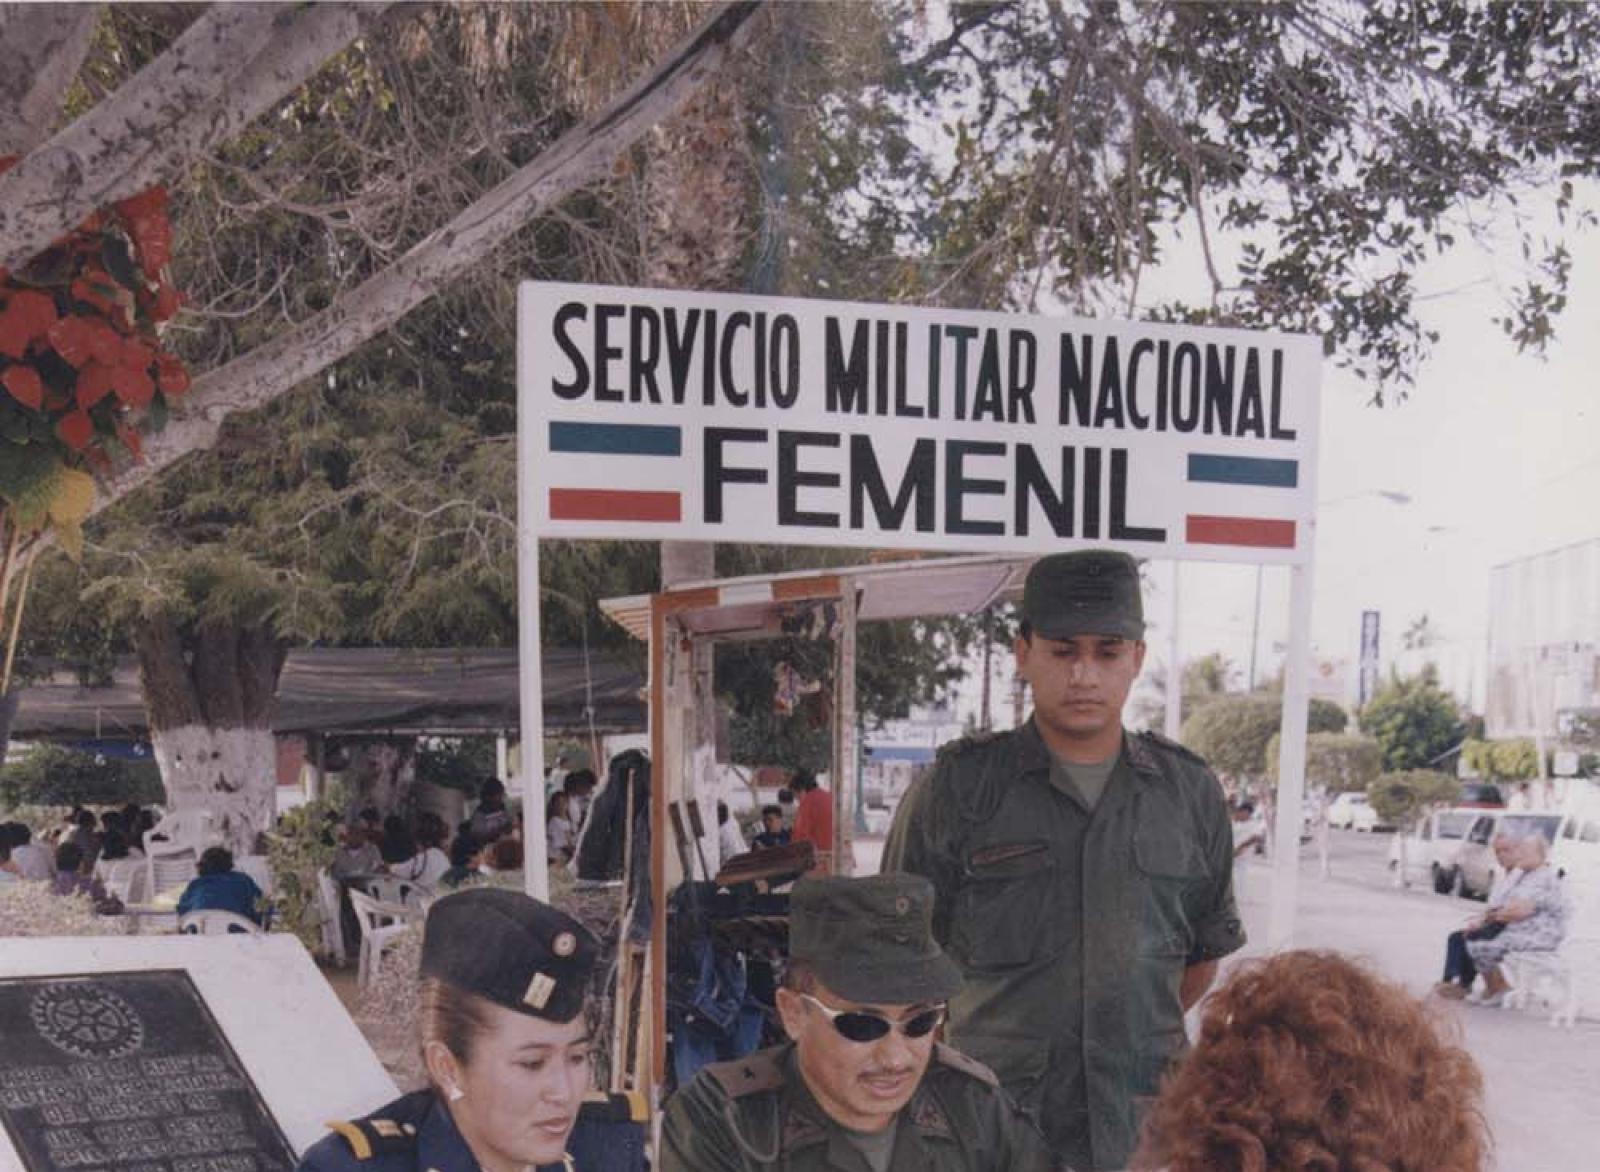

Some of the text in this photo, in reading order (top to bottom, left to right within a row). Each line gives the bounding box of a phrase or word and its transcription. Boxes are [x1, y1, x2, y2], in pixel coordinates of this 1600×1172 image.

[552, 301, 1297, 441] SERVICIO MILITAR NACIONAL
[703, 427, 1167, 543] FEMENIL
